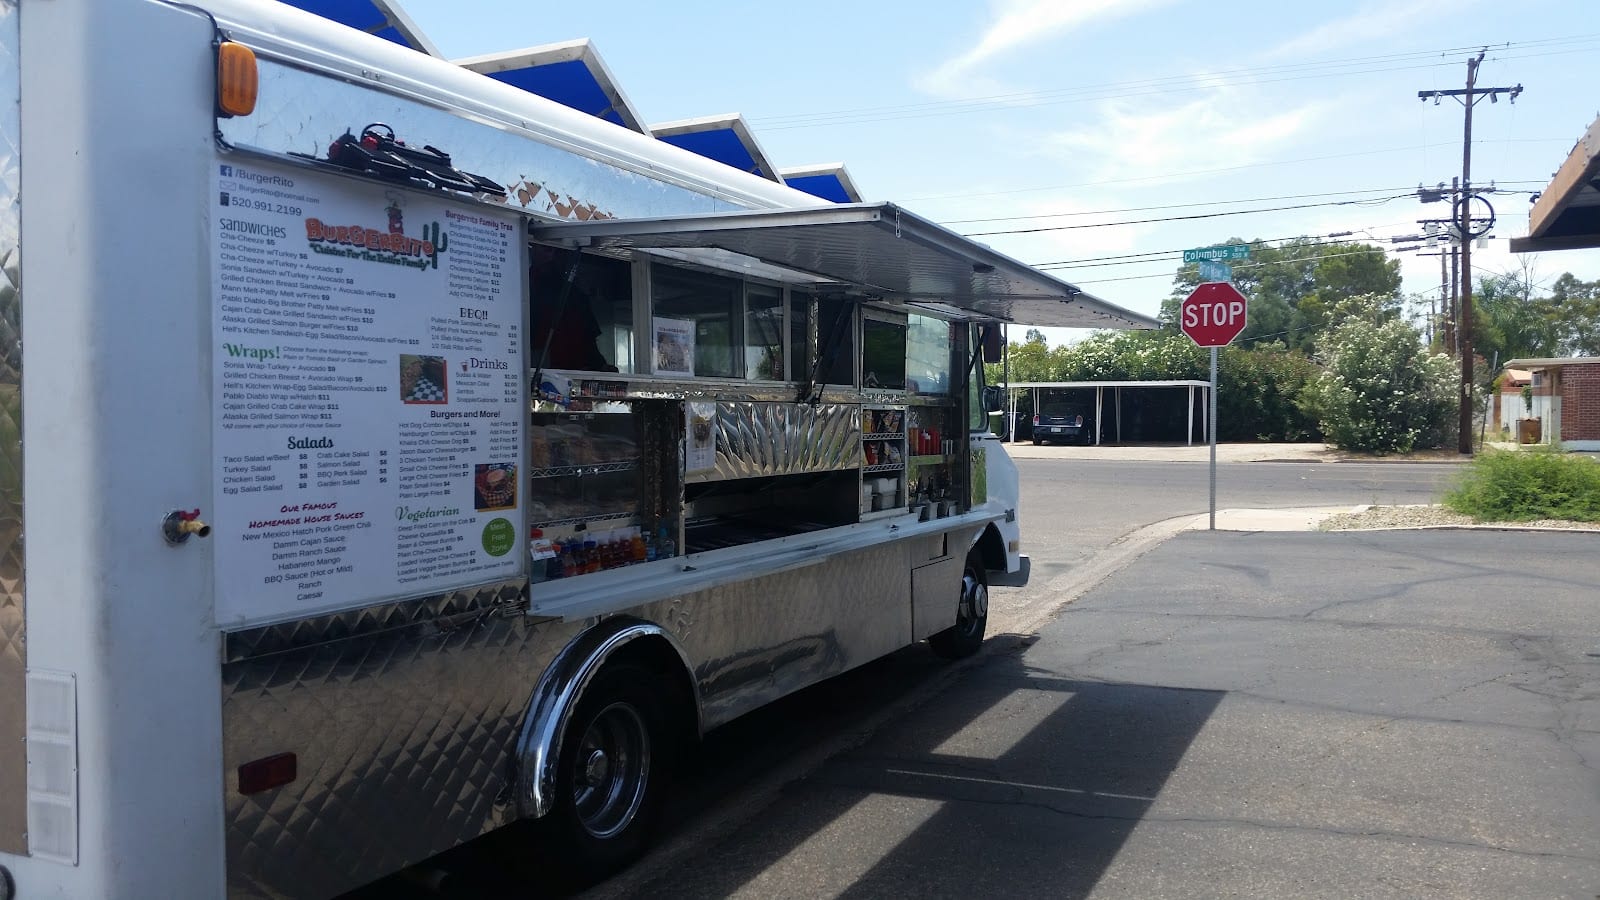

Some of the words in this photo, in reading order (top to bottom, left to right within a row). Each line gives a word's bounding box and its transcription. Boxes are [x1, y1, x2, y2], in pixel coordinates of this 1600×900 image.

[235, 169, 294, 187] /BurgerRito
[231, 197, 302, 216] 520.991.2199
[478, 217, 499, 230] Family
[500, 222, 513, 231] Tree
[346, 248, 360, 259] For
[360, 250, 376, 261] The
[376, 253, 401, 265] Entire
[1184, 248, 1228, 262] Columbus
[1185, 301, 1243, 327] STOP
[223, 343, 280, 362] Wraps!
[470, 357, 508, 370] Drinks
[287, 436, 334, 450] Salads
[395, 506, 459, 522] Vegetarian
